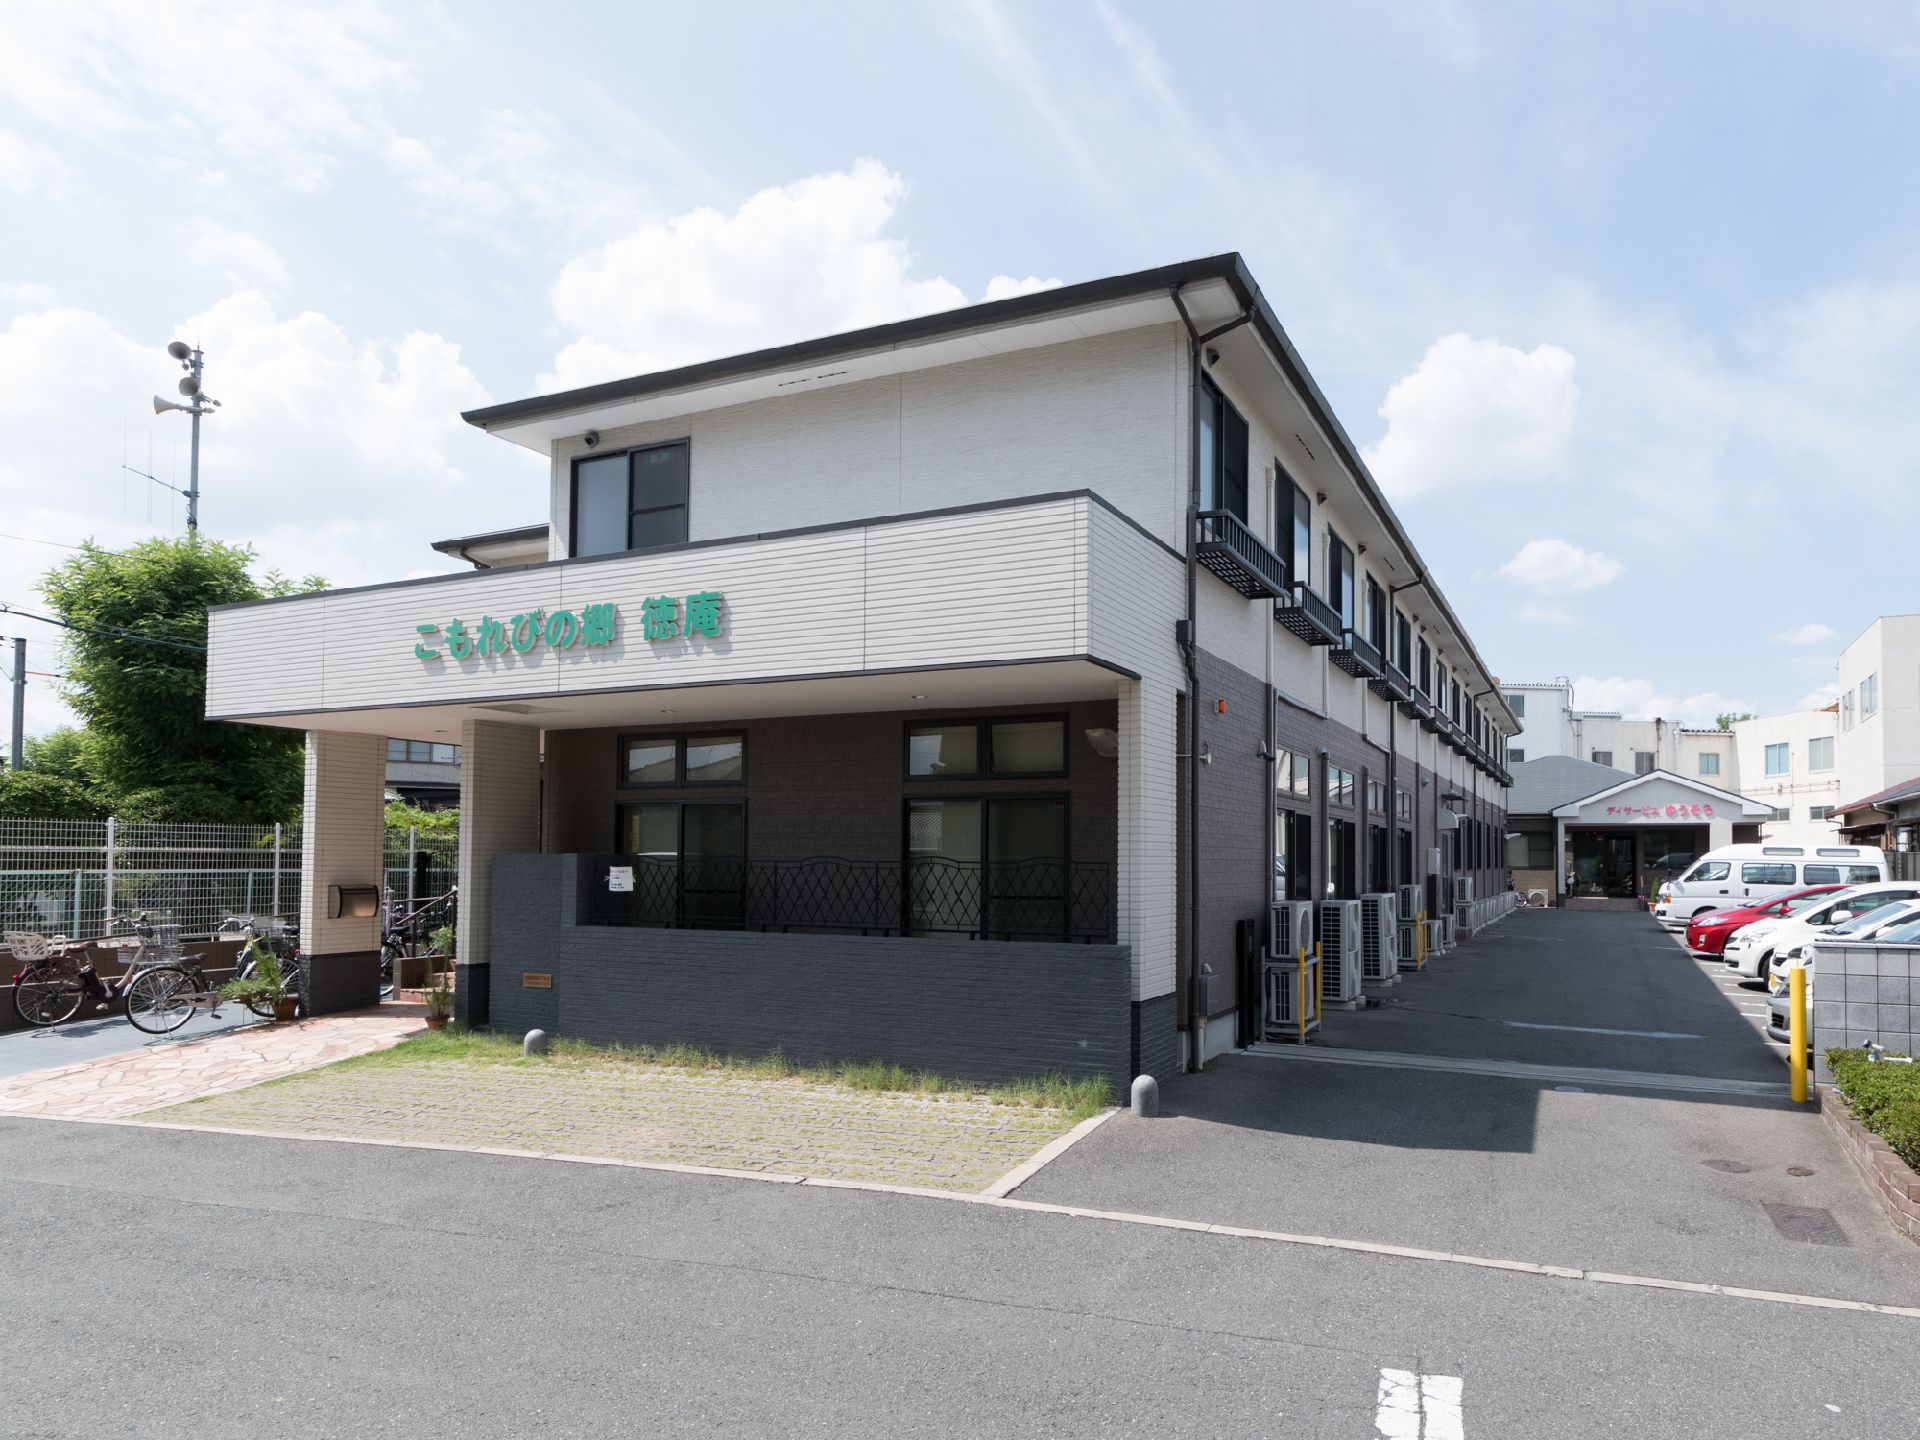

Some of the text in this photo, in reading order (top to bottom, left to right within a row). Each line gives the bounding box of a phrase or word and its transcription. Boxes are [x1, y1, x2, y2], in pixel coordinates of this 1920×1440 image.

[415, 591, 722, 659] こもれびの郷 徳庵
